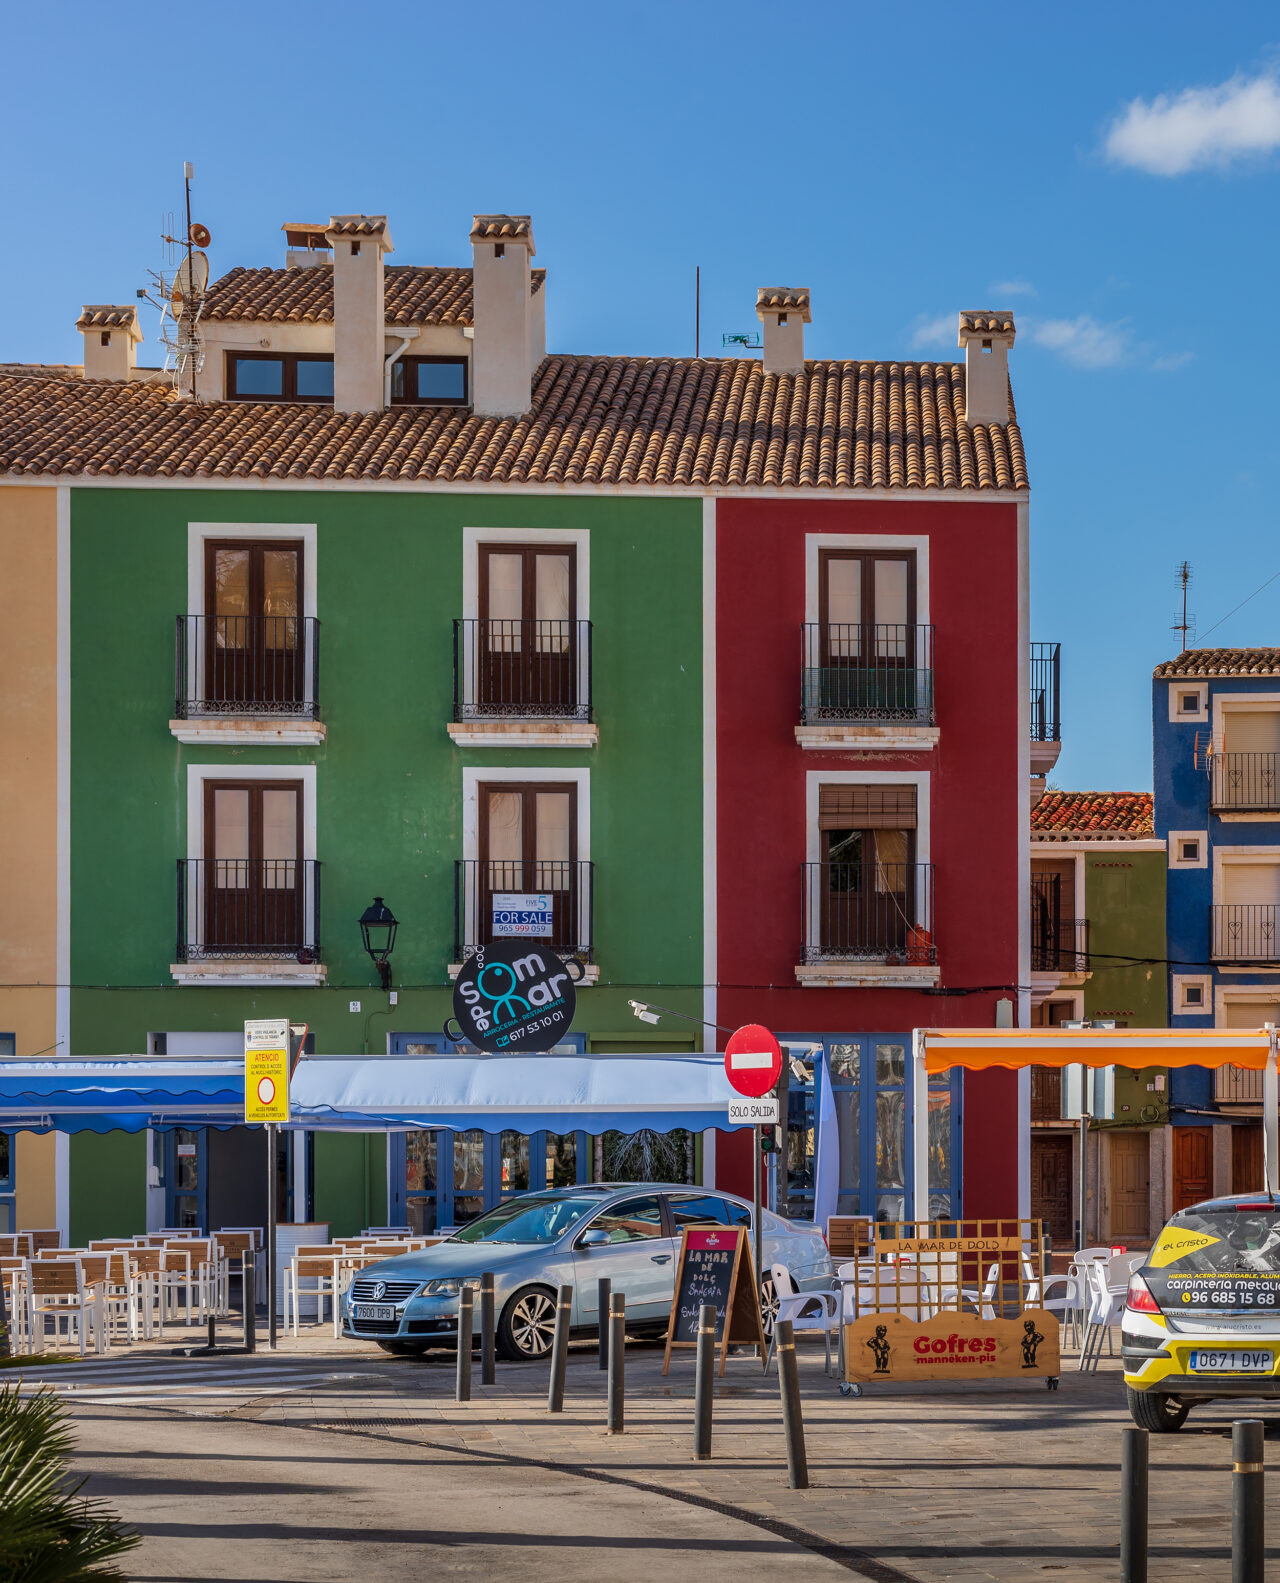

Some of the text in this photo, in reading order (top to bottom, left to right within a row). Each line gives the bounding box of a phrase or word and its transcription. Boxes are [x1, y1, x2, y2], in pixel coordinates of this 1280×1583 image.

[493, 912, 553, 924] FOR SALE
[521, 997, 566, 1021] RESTAURANTE
[509, 1010, 565, 1041] 617 53 10 01
[730, 1105, 775, 1117] SOLO SALIDA
[898, 1242, 912, 1251] LA
[918, 1241, 946, 1251] MAR
[949, 1241, 963, 1250] DE
[688, 1249, 728, 1263] LA MAR
[701, 1262, 713, 1271] DE
[1191, 1291, 1275, 1305] 96 685 15 68
[358, 1307, 391, 1319] 7600 DPB
[913, 1333, 997, 1354] Gofres
[916, 1352, 996, 1364] manneken-pis
[1200, 1353, 1270, 1367] 0671 DVP
